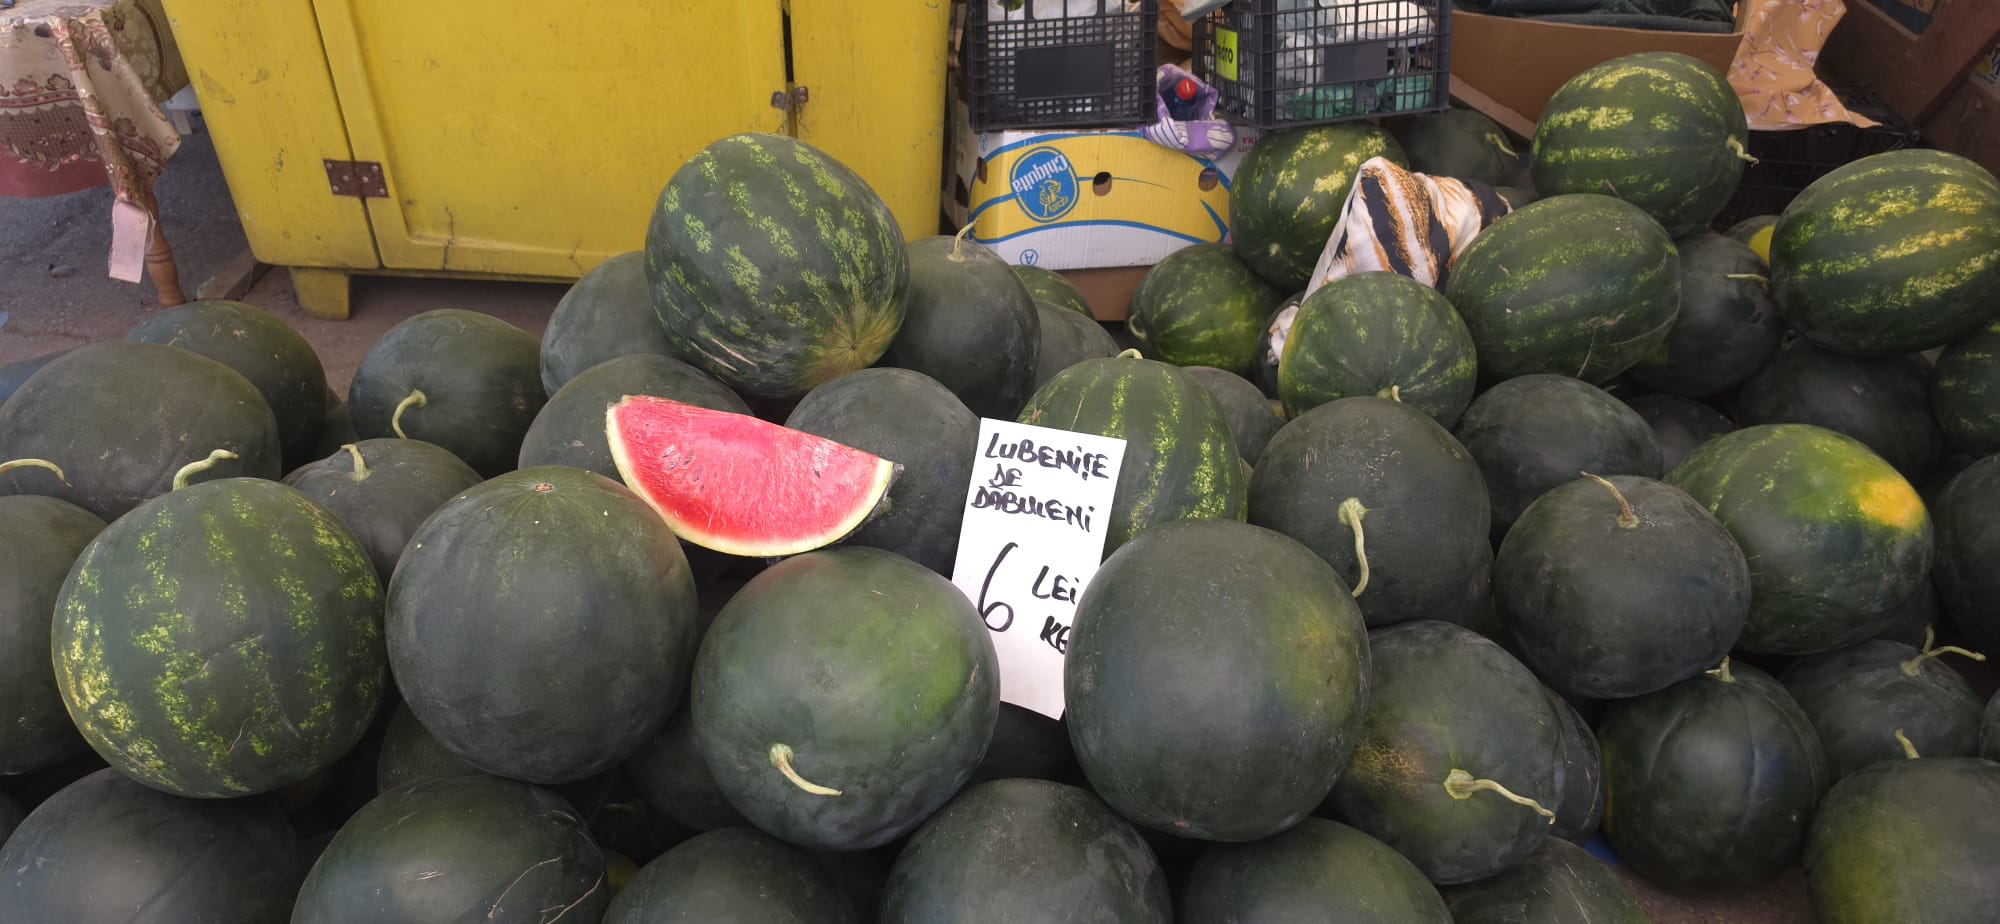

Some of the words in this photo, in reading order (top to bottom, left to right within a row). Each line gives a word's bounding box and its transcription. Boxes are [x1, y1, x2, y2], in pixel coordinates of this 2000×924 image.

[1012, 154, 1068, 193] Chiquita
[988, 463, 1023, 487] DE
[977, 542, 1019, 632] 6
